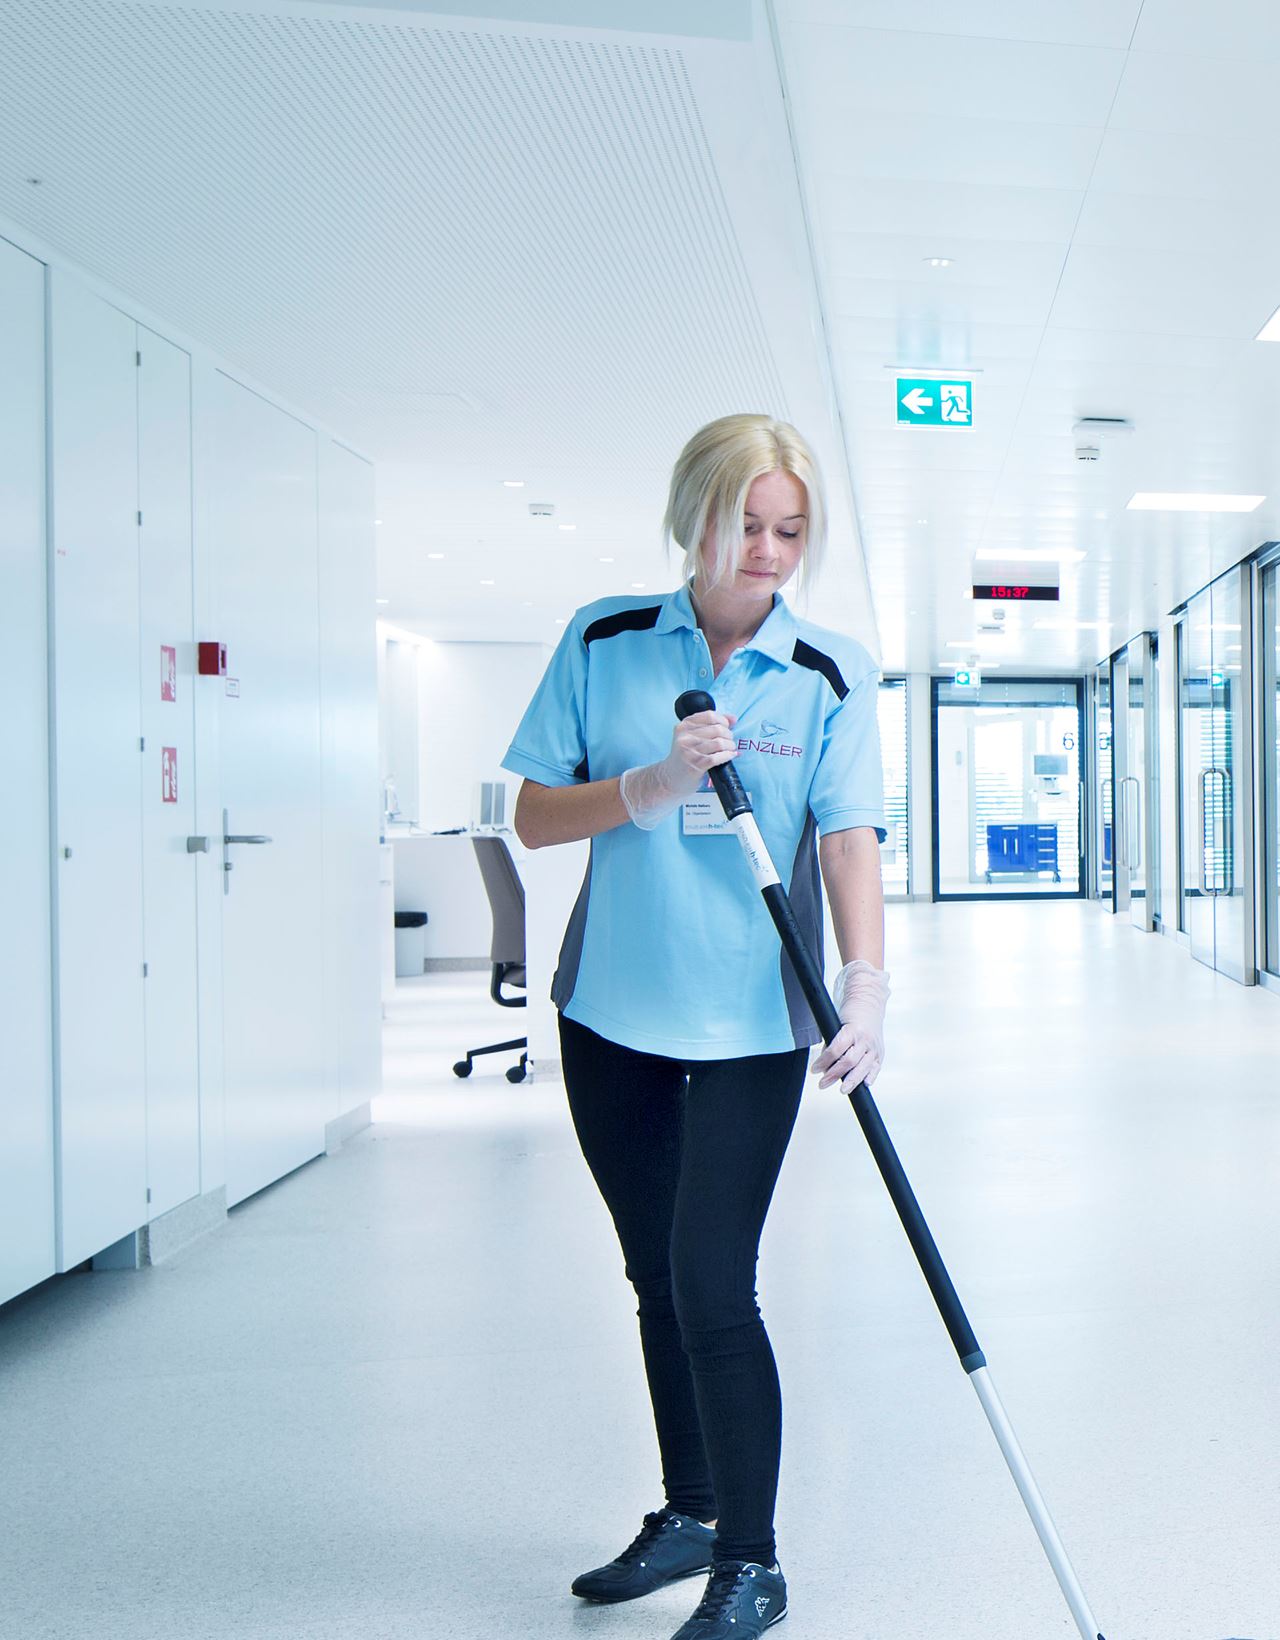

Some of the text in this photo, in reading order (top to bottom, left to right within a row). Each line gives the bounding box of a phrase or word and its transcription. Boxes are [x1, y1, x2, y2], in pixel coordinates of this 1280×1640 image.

[991, 586, 1029, 598] 15:37
[737, 739, 803, 758] ENZLER
[1063, 732, 1075, 751] 6
